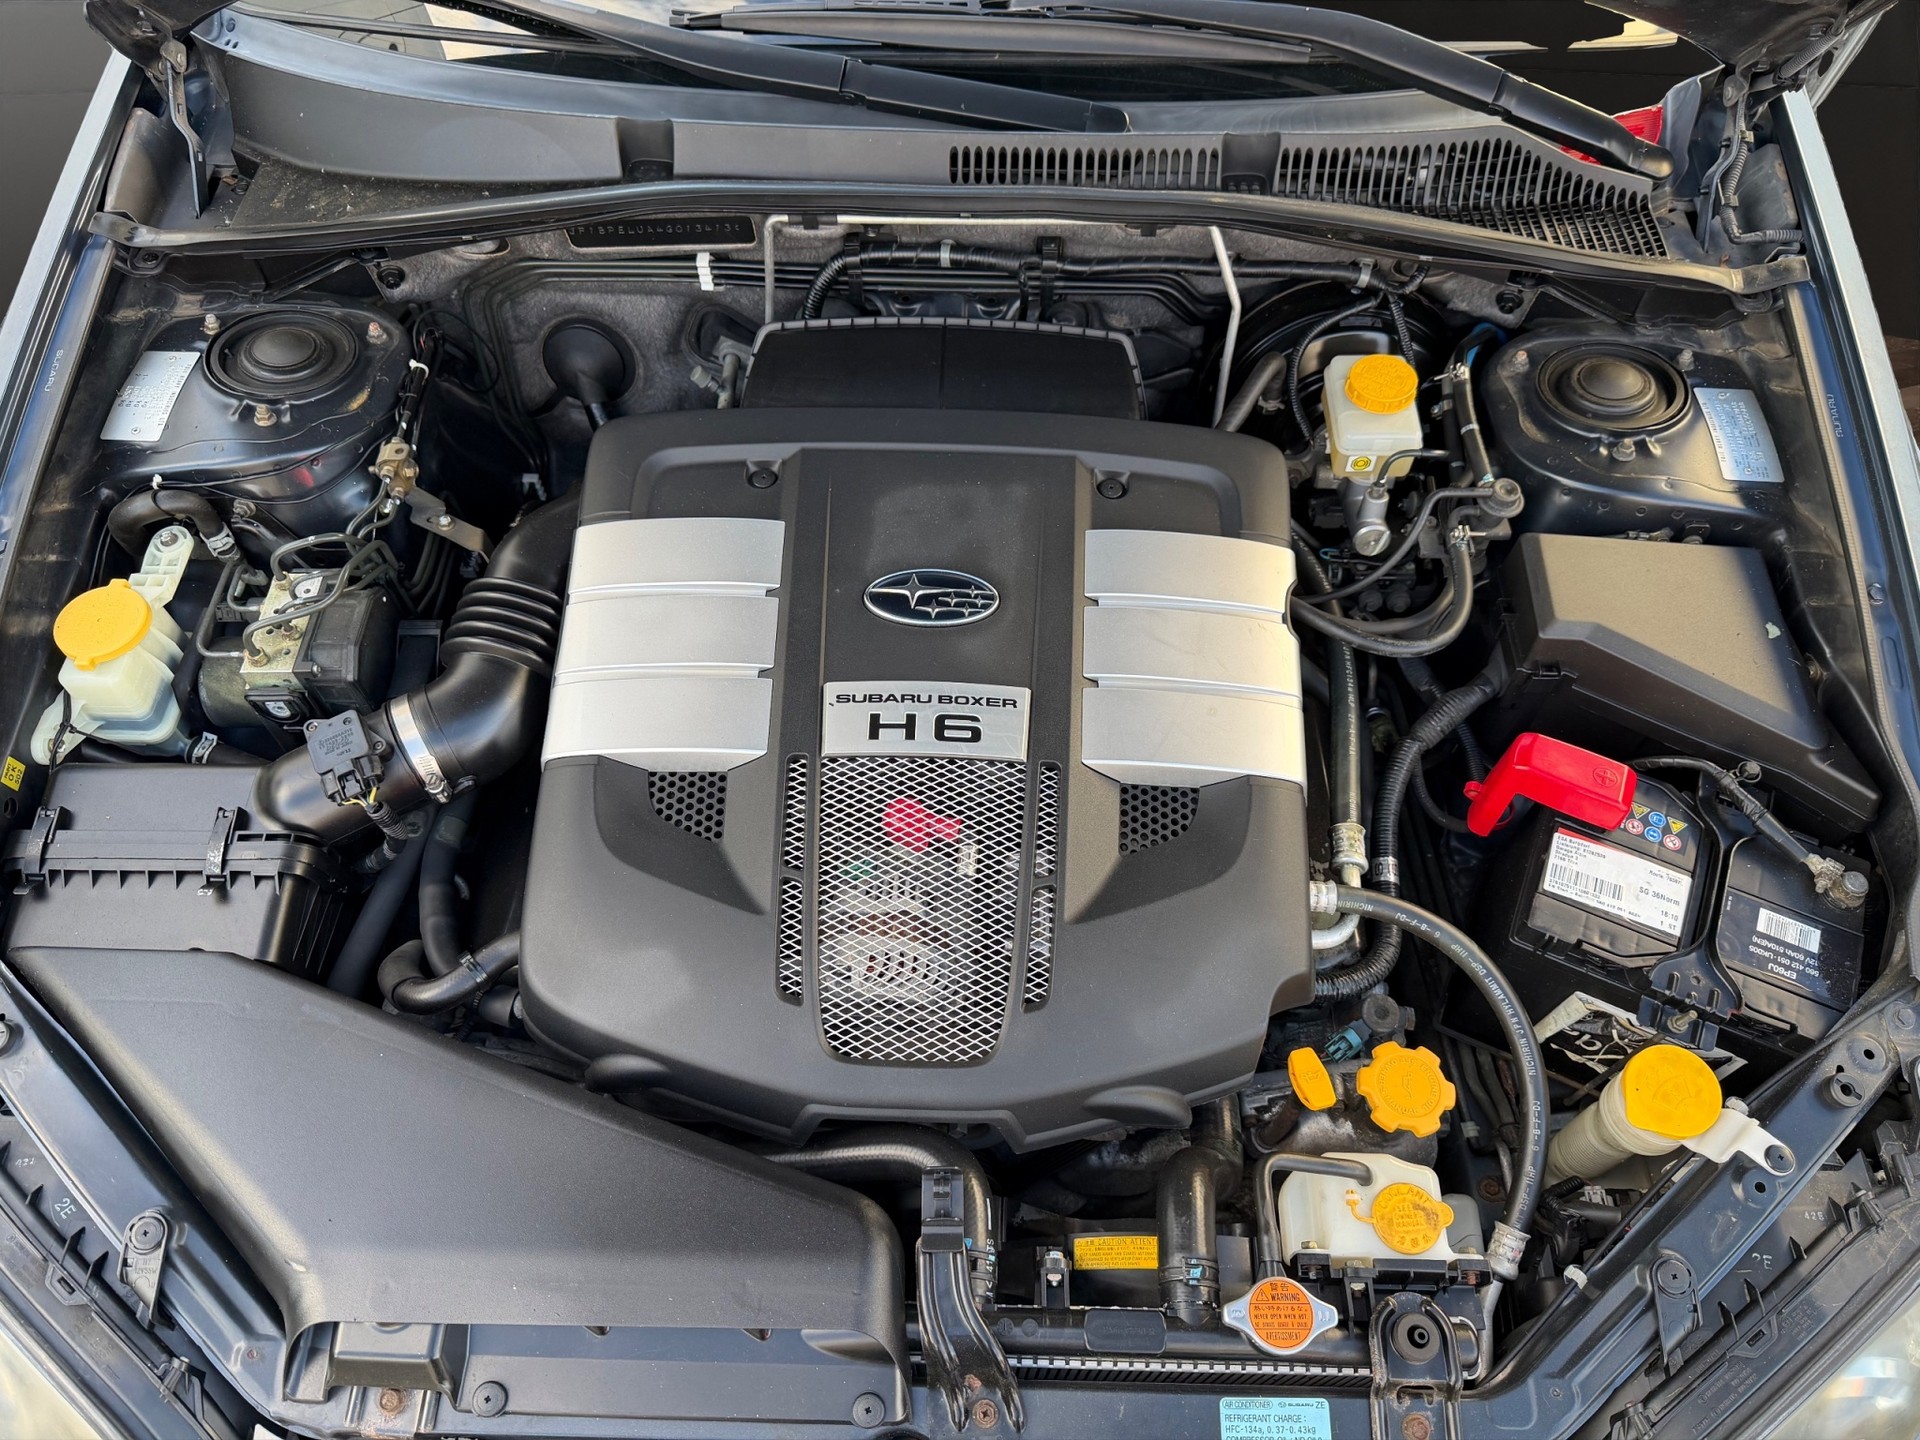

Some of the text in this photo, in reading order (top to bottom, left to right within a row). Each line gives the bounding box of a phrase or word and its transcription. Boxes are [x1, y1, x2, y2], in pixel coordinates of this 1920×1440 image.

[44, 349, 63, 391] SUBARU
[1827, 394, 1843, 437] SUBARU
[836, 694, 1018, 708] SUBARU BOXER
[14, 769, 22, 785] 502
[1639, 886, 1680, 906] SG 36Norm
[1337, 901, 1374, 912] NICHIRIN
[1661, 910, 1679, 922] 18:10
[1752, 935, 1818, 966] 12V 60Ah 510A(EN)
[1777, 956, 1790, 965] 051
[1791, 961, 1804, 971] 412
[1768, 963, 1796, 980] EP60J
[1805, 967, 1819, 977] 560
[1484, 975, 1515, 1014] HYLAMMIT
[1510, 1016, 1524, 1036] JPN
[1520, 1041, 1536, 1076] NICHIRIN
[1377, 1187, 1430, 1209] COOLANT
[1271, 1293, 1300, 1302] WARNING
[1315, 1401, 1326, 1409] ZE
[1225, 1414, 1271, 1423] REFRIGERANT
[1273, 1414, 1302, 1423] CHARGE
[1225, 1425, 1265, 1434] HFC-134a,
